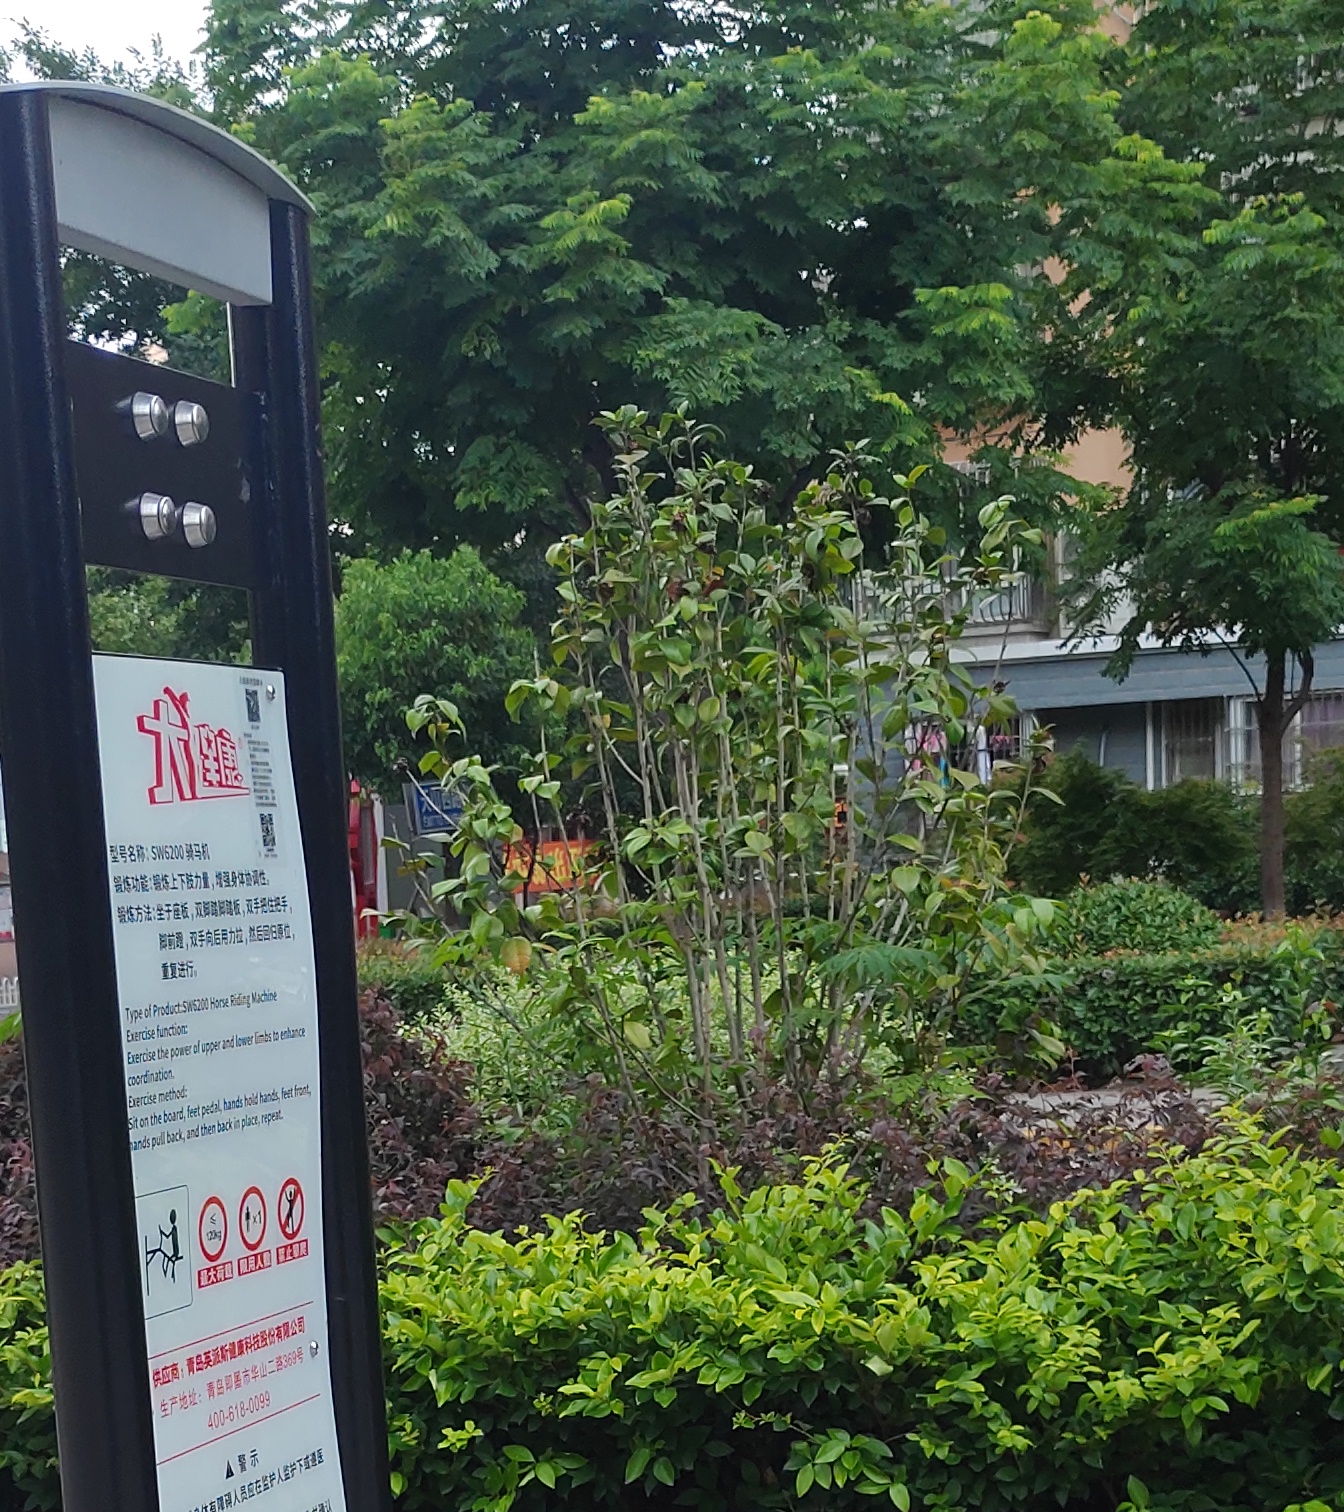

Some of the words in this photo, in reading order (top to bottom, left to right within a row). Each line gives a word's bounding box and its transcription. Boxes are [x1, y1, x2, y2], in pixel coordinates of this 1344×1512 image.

[125, 1008, 143, 1024] Type
[144, 1004, 152, 1019] of
[210, 997, 230, 1010] Horse
[230, 993, 251, 1008] Riding
[252, 989, 277, 1004] Machine
[127, 1027, 156, 1043] Exercise
[157, 1022, 188, 1038] function:
[127, 1048, 156, 1065] Exercise
[157, 1046, 169, 1060] the
[170, 1045, 192, 1061] power
[193, 1040, 201, 1054] of
[201, 1041, 221, 1056] upper
[222, 1035, 235, 1050] and
[236, 1034, 254, 1047] lower
[254, 1030, 272, 1045] limbs
[273, 1031, 279, 1042] to
[280, 1027, 306, 1040] enhance
[128, 1067, 175, 1086] coordination.
[129, 1092, 157, 1108] Exercise
[158, 1085, 188, 1103] method:
[139, 1117, 149, 1128] on
[150, 1112, 162, 1126] the
[163, 1107, 186, 1124] board,
[187, 1105, 201, 1118] feet
[202, 1099, 222, 1119] pedal,
[223, 1095, 243, 1111] hands
[244, 1092, 258, 1107] hold
[260, 1088, 280, 1104] hands,
[281, 1087, 294, 1100] feet
[294, 1084, 312, 1097] front,
[152, 1132, 166, 1150] pull
[167, 1128, 186, 1144] back,
[187, 1124, 200, 1140] and
[201, 1123, 216, 1137] then
[217, 1118, 233, 1133] back
[241, 1115, 260, 1131] place,
[261, 1109, 284, 1126] repeat.
[208, 1391, 271, 1430] 400-618-0099
[238, 1449, 259, 1473] 警示
